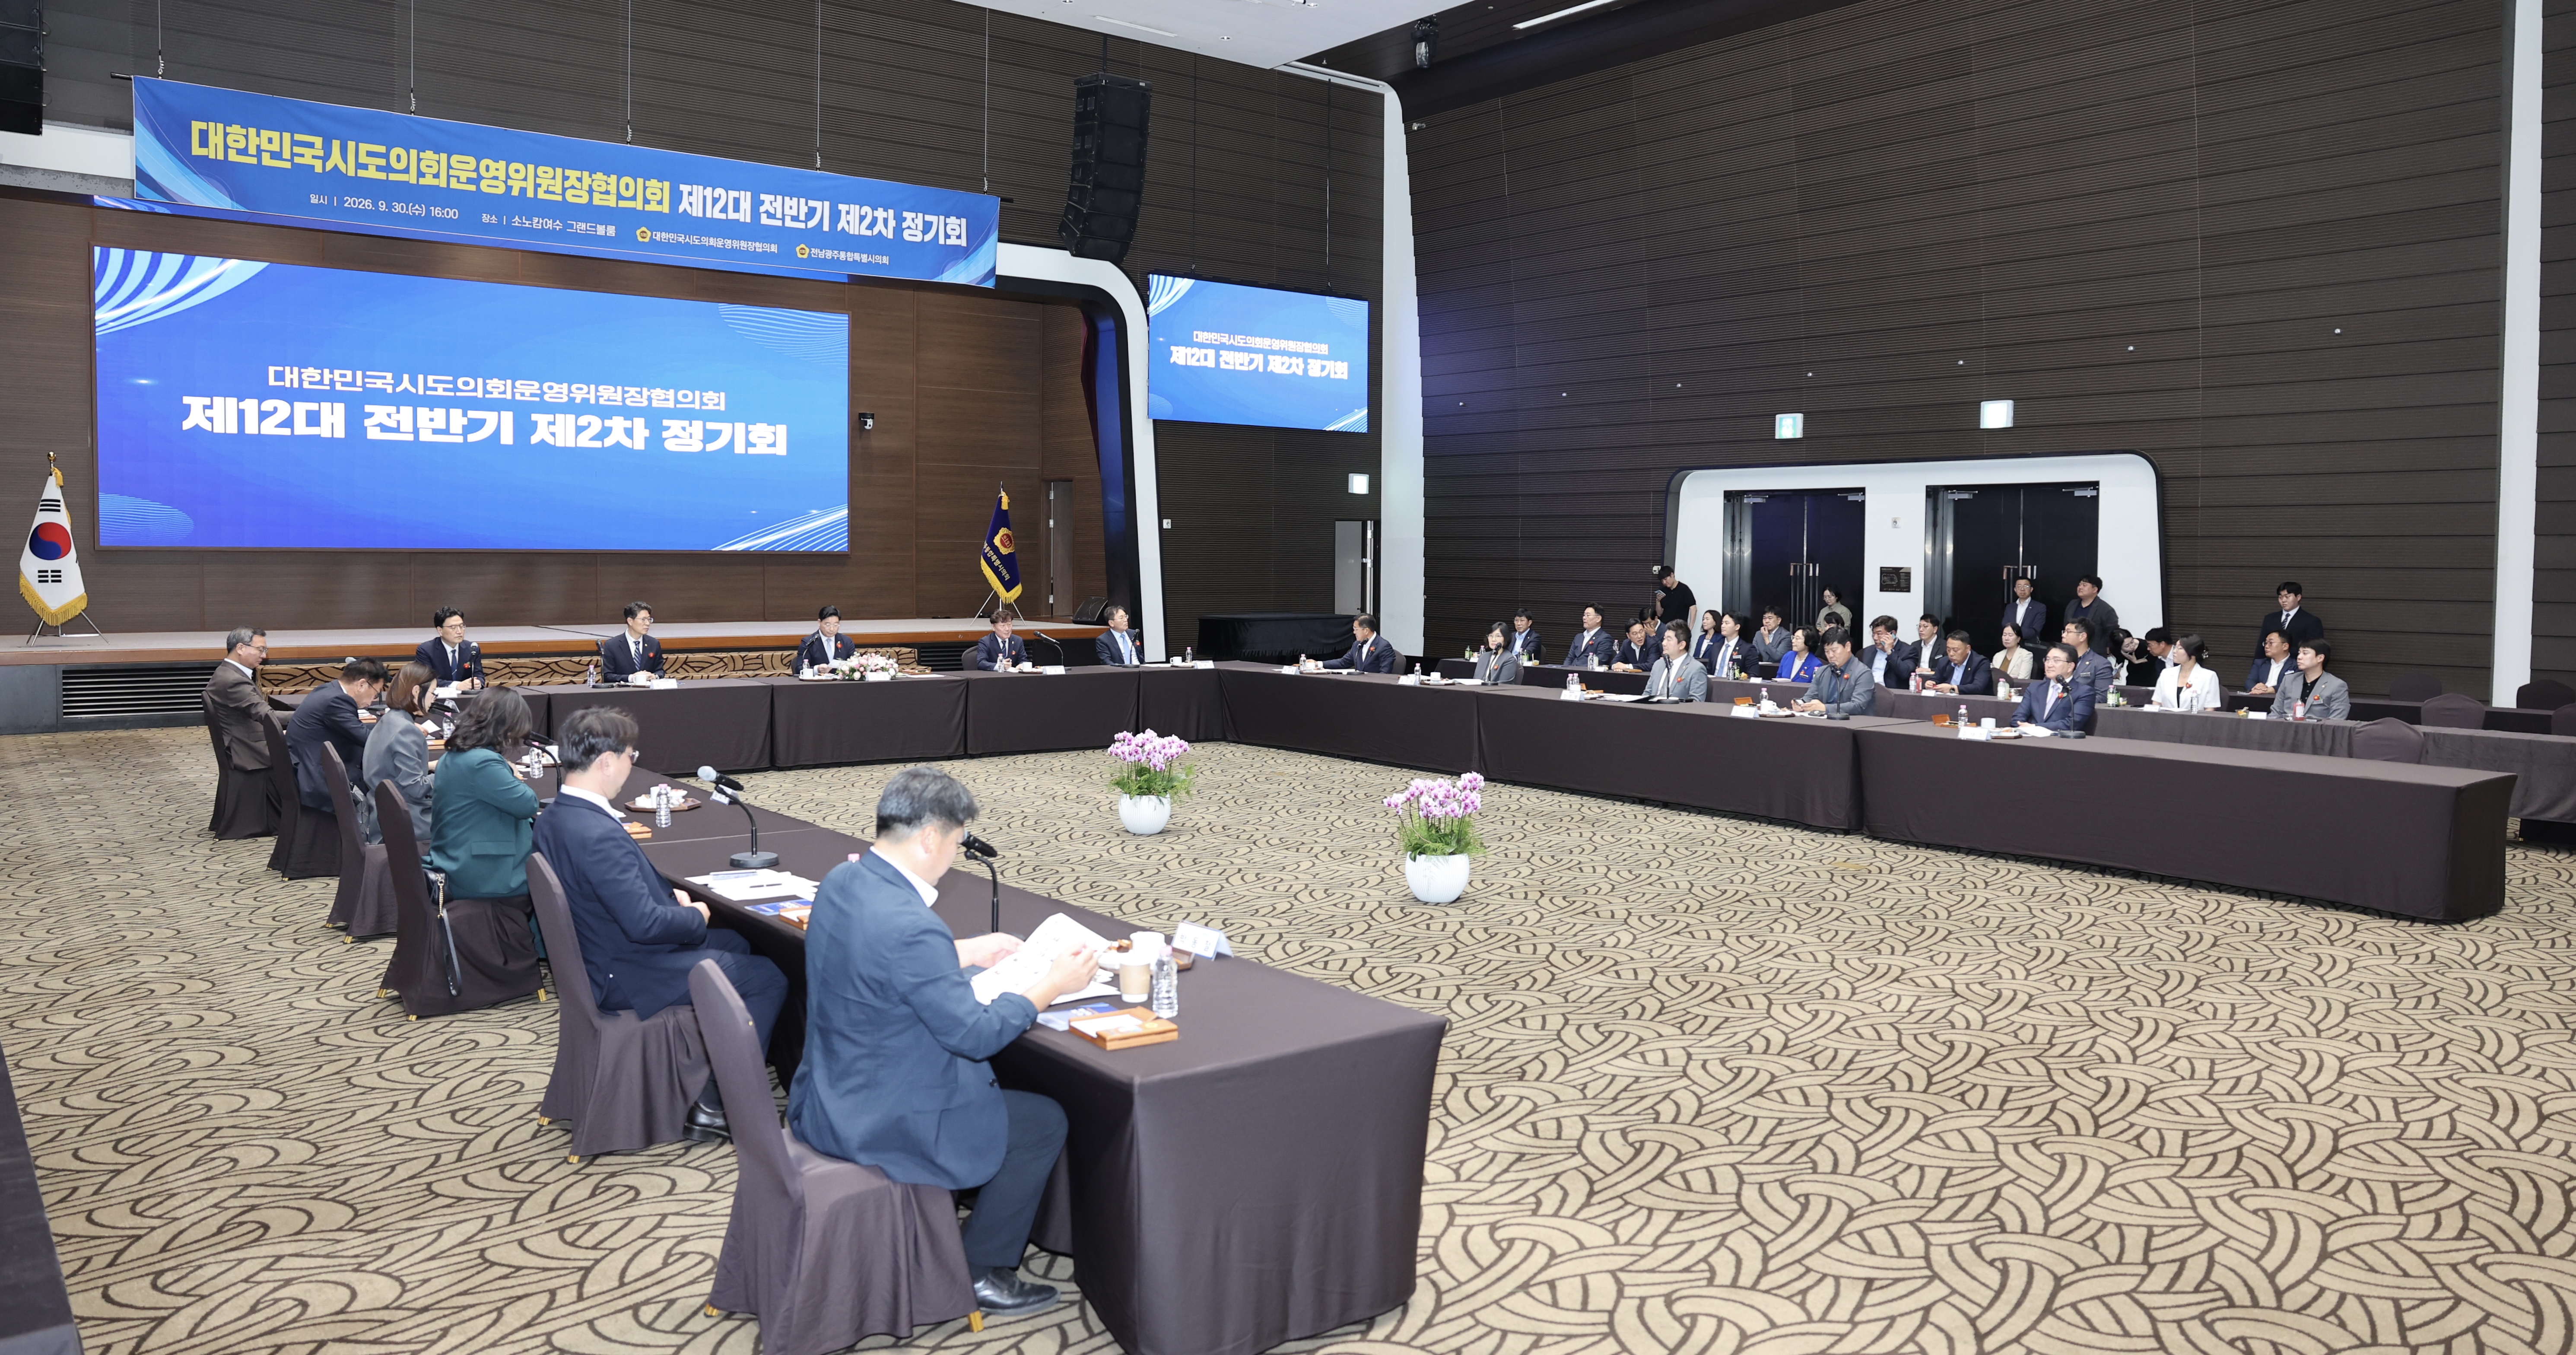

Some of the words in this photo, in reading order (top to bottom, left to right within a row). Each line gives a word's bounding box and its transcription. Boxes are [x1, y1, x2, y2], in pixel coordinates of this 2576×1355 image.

[191, 120, 670, 213] 대한민국시도의회운영위원장협의회
[679, 184, 751, 223] 제12대
[759, 193, 830, 232] 전반기
[837, 202, 896, 239] 제2차
[902, 210, 967, 247] 정기회
[310, 194, 327, 205] 일시
[343, 197, 375, 210] 2026.
[378, 200, 388, 211] 9.
[391, 202, 426, 216] 30.(수)
[429, 206, 458, 219] 16:00
[481, 213, 498, 223] 장소
[511, 215, 563, 231] 소노캄여수
[566, 220, 616, 237] 그랜드볼룸
[652, 231, 778, 254] 대한민국시도의회운영위원장협의회
[810, 248, 889, 265] 전남광주통합특별시의회
[1193, 331, 1329, 355] 대한민국시도의회운영위원장협의회
[1170, 346, 1215, 368] 제12대
[1219, 350, 1264, 372] 전반기
[1267, 355, 1305, 375] 제2차
[1307, 359, 1348, 379] 정기회
[268, 366, 726, 411] 대한민국시도의회운영위원장협의회
[181, 395, 345, 438] 제12대
[363, 404, 514, 445] 전반기
[530, 413, 649, 451] 제2차
[662, 419, 787, 456] 정기회
